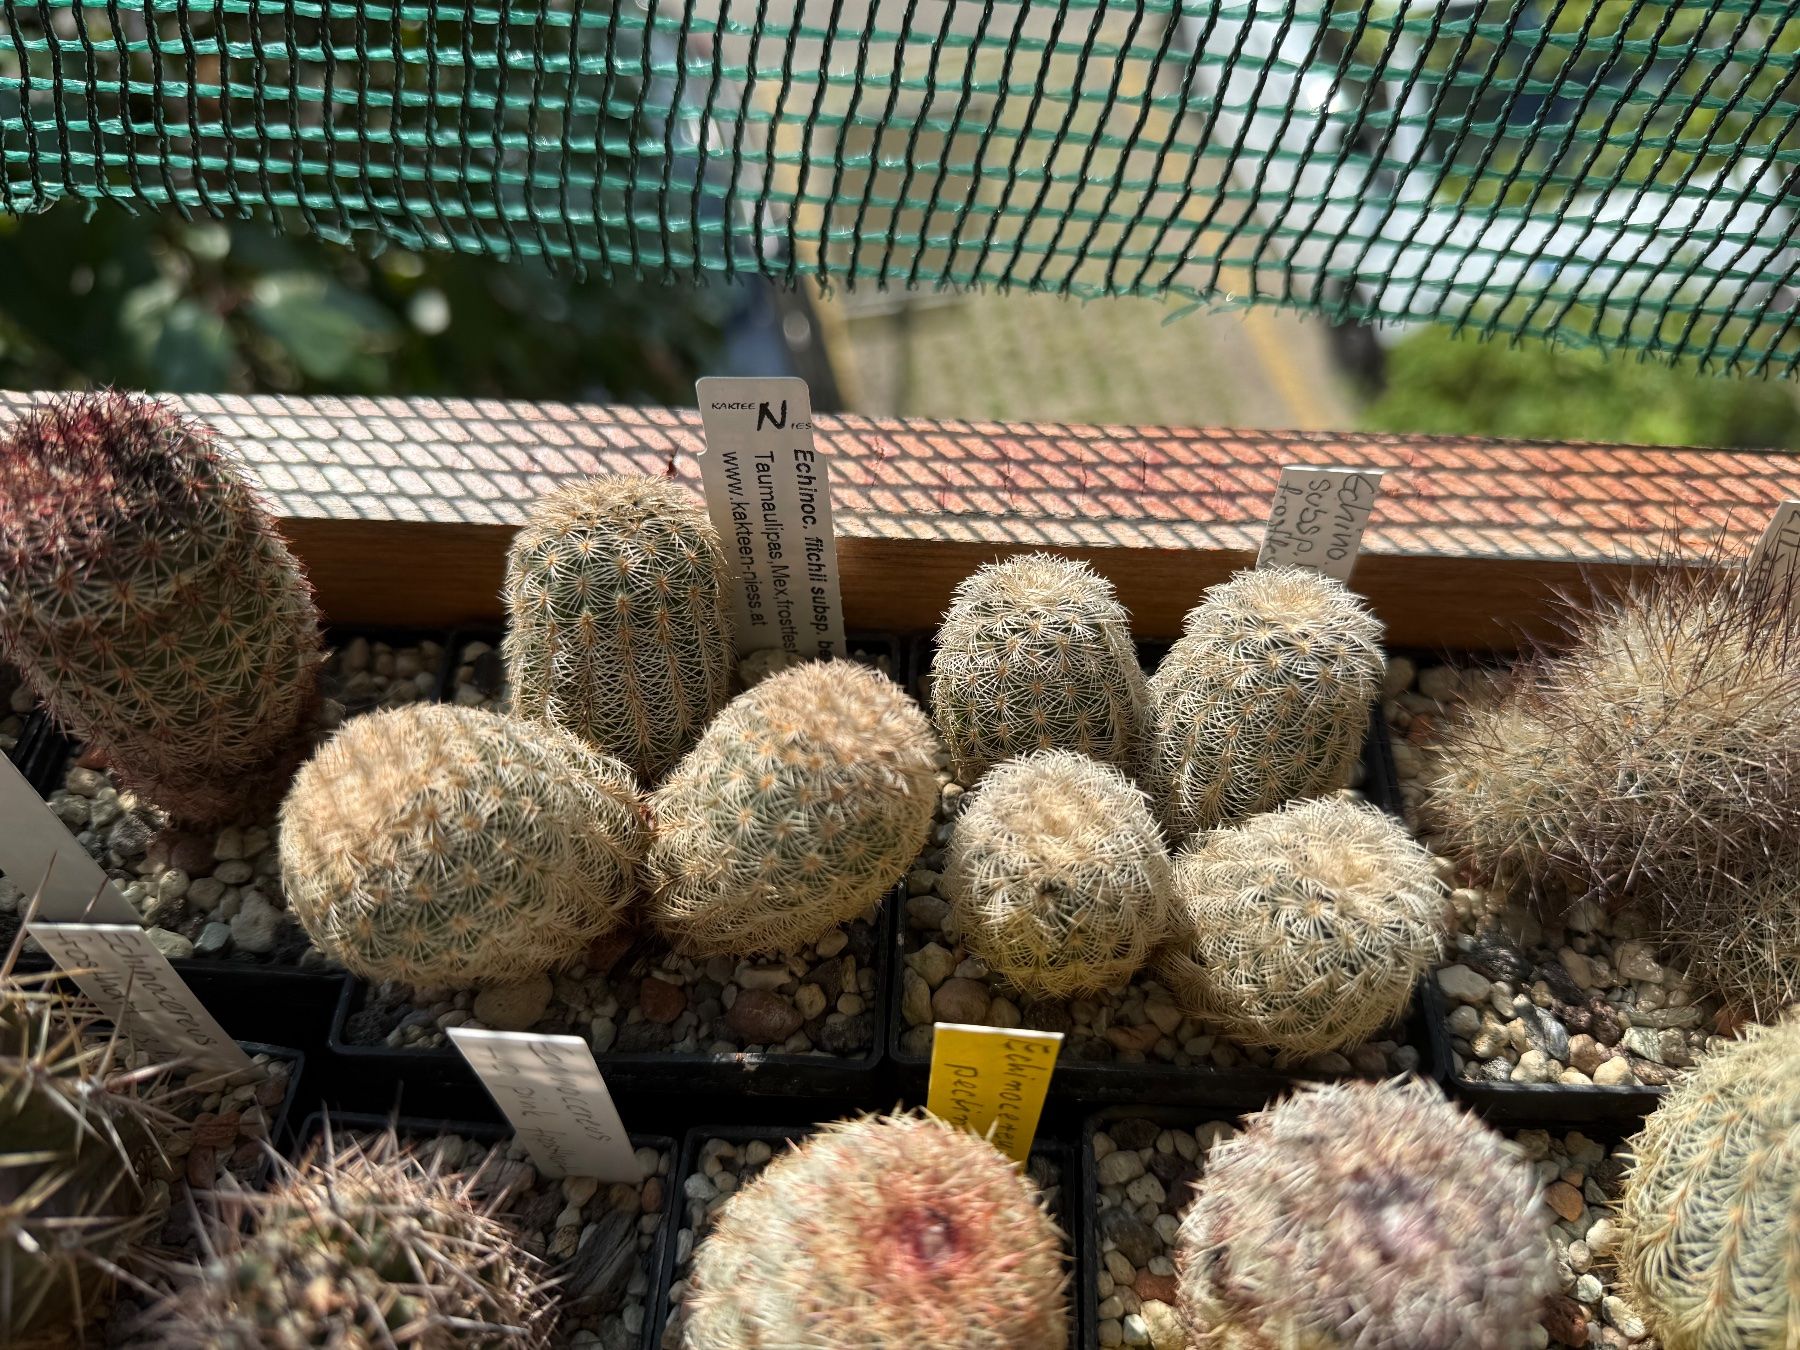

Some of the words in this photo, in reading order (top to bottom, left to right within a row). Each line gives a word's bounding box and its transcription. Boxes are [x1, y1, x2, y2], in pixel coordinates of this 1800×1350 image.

[793, 449, 818, 530] Echinoc.
[722, 451, 768, 627] www.kakteen-niess.at
[804, 536, 828, 583] fitchii
[810, 586, 831, 636] subsp.
